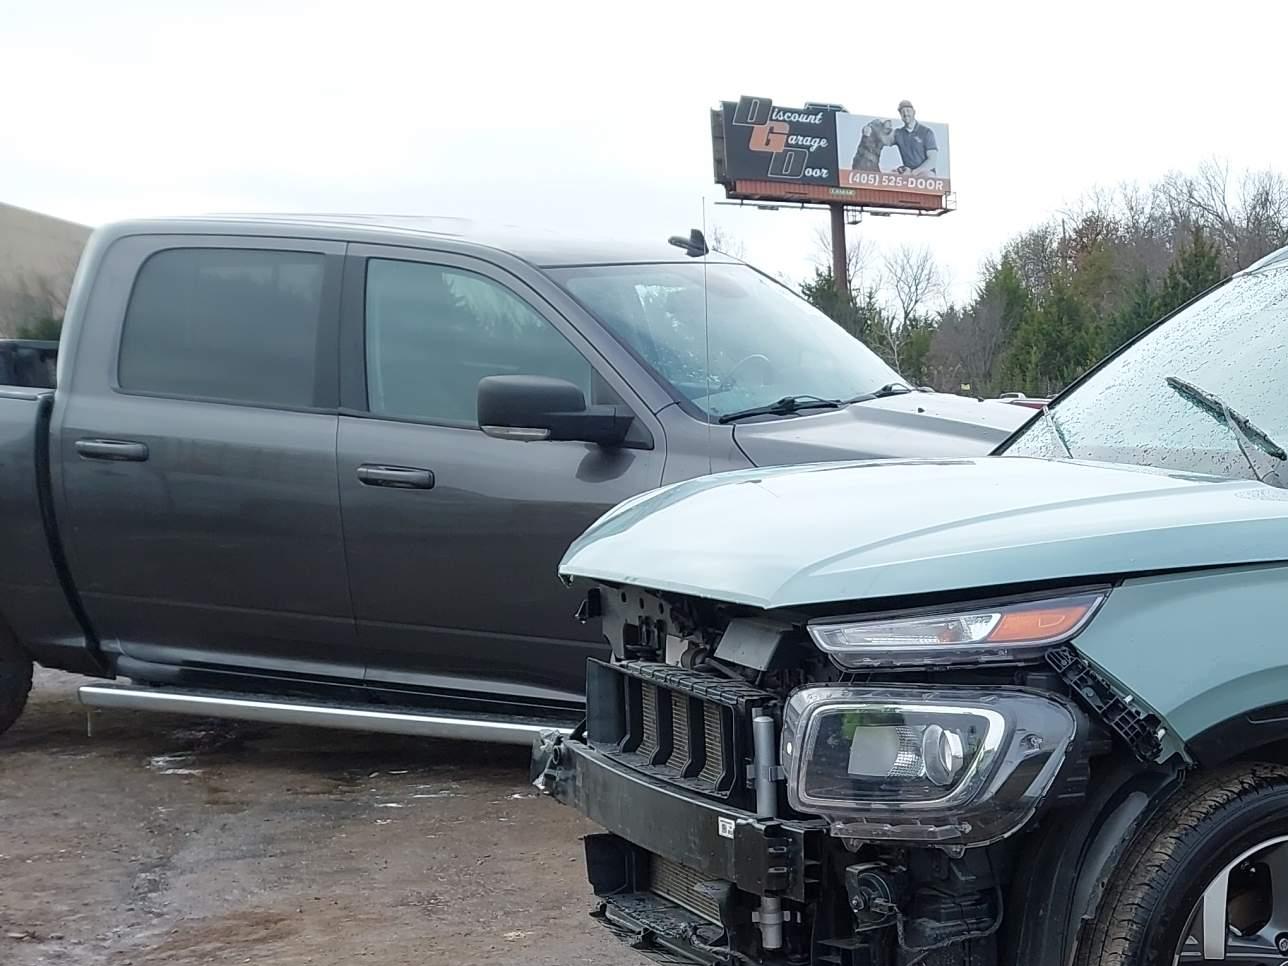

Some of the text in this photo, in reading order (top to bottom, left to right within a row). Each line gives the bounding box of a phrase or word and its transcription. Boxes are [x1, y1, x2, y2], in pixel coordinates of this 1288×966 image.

[733, 95, 823, 126] Discount
[749, 121, 829, 152] Garage
[768, 147, 829, 178] Door
[848, 172, 944, 191] (405) 525-DOOR
